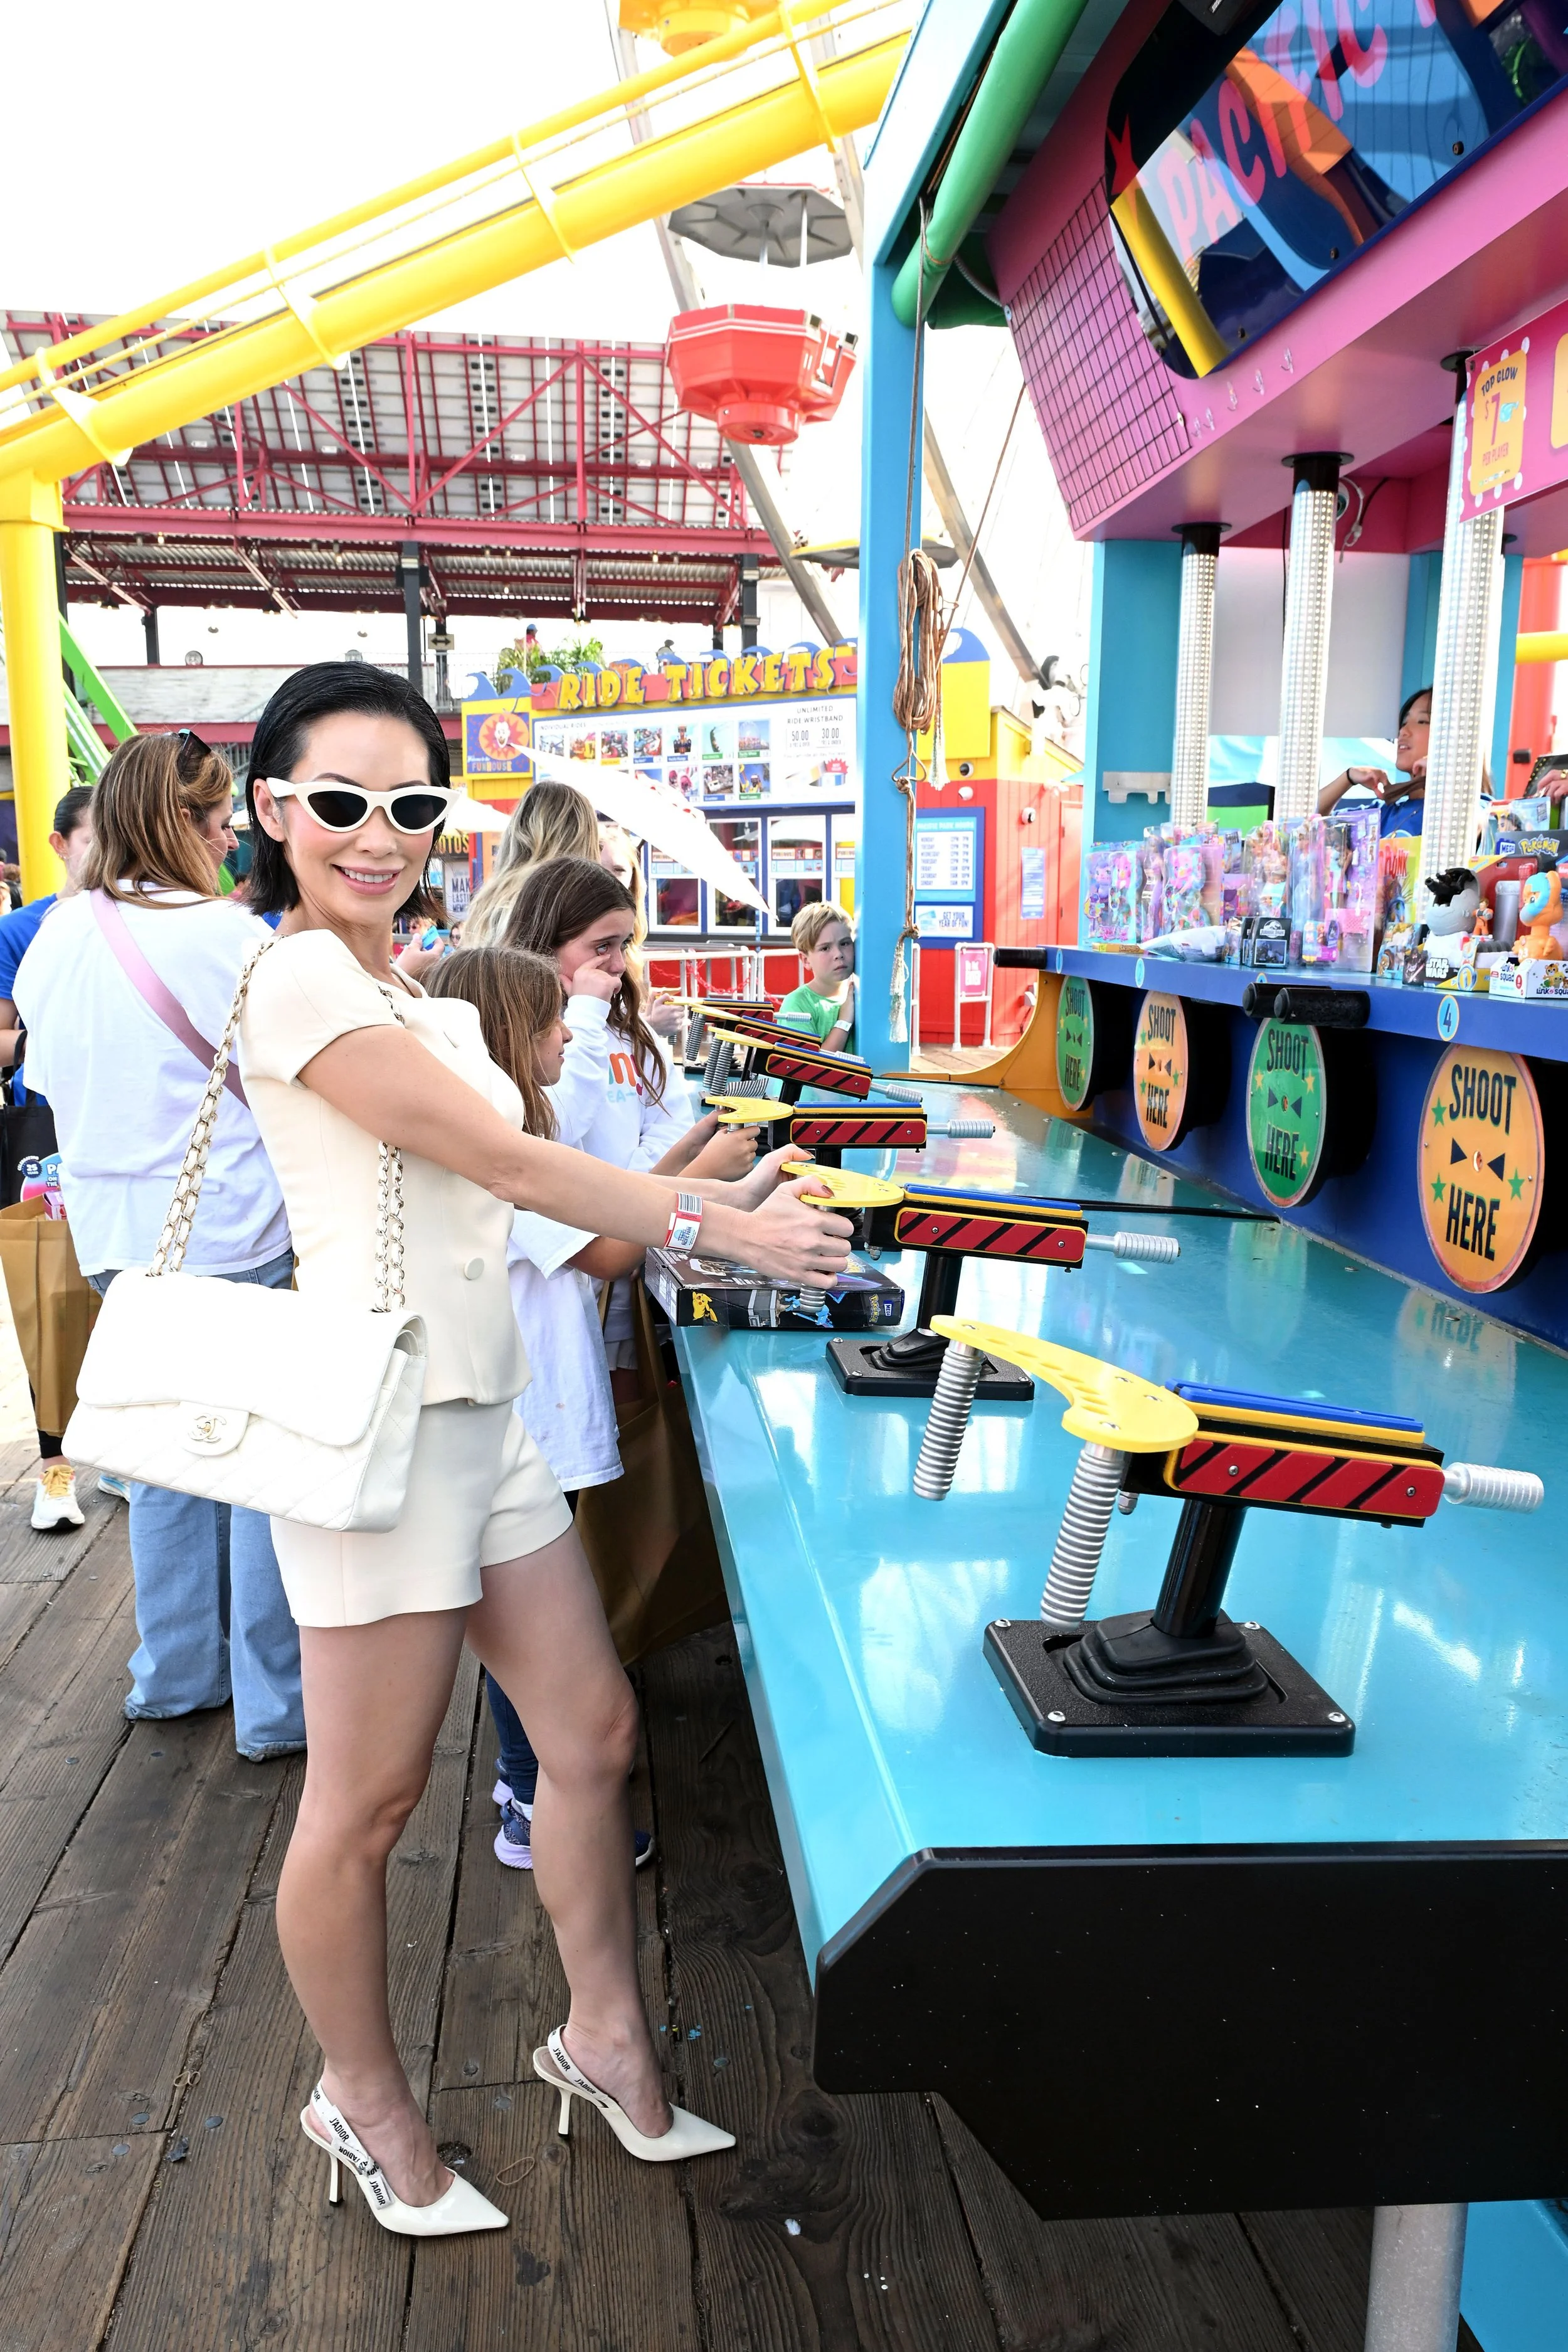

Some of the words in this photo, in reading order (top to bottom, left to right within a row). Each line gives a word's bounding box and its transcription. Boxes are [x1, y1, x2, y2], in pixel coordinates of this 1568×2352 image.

[1481, 375, 1495, 396] TOP
[1496, 366, 1518, 383] GLOW
[1482, 450, 1493, 467] PER
[1493, 442, 1509, 462] PLAYER
[559, 666, 646, 712] RIDE
[666, 647, 837, 702] TICKETS
[803, 714, 844, 723] WRISTBAND
[472, 761, 512, 772] FUNHOUSE
[1502, 844, 1515, 853] MEGA
[1426, 958, 1449, 968] STAR
[1426, 967, 1448, 978] WARS
[1066, 987, 1086, 1021] SHOOT
[1148, 1004, 1176, 1047] SHOOT
[1443, 1004, 1452, 1033] 4
[1266, 1028, 1309, 1082] SHOOT
[1064, 1053, 1081, 1091] HERE
[1146, 1083, 1170, 1129] HERE
[1449, 1063, 1517, 1135] SHOOT
[1264, 1121, 1300, 1182] HERE
[26, 1163, 38, 1172] 25
[1445, 1182, 1500, 1261] HERE
[553, 2048, 571, 2072] J'ADIOR
[575, 2079, 596, 2094] J'ADIOR
[329, 2117, 349, 2143] J'ADIOR
[339, 2146, 361, 2163] J'ADIOR
[369, 2180, 386, 2206] J'ADIOR
